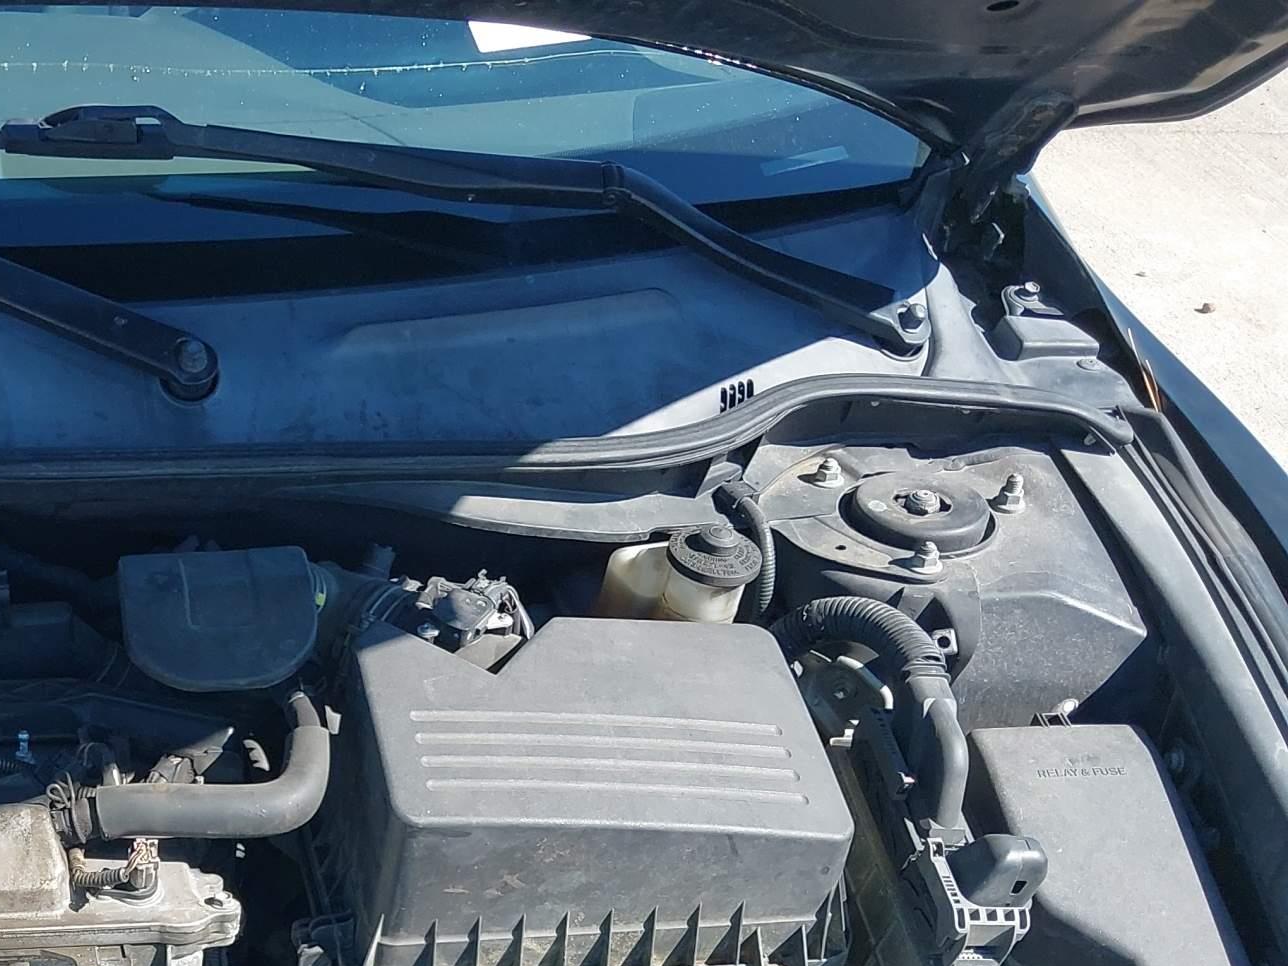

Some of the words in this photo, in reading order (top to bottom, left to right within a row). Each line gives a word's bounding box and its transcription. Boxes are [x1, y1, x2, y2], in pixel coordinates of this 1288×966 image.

[1036, 768, 1078, 778] RELAY
[1080, 768, 1090, 777] &
[1091, 767, 1127, 776] FUSE
